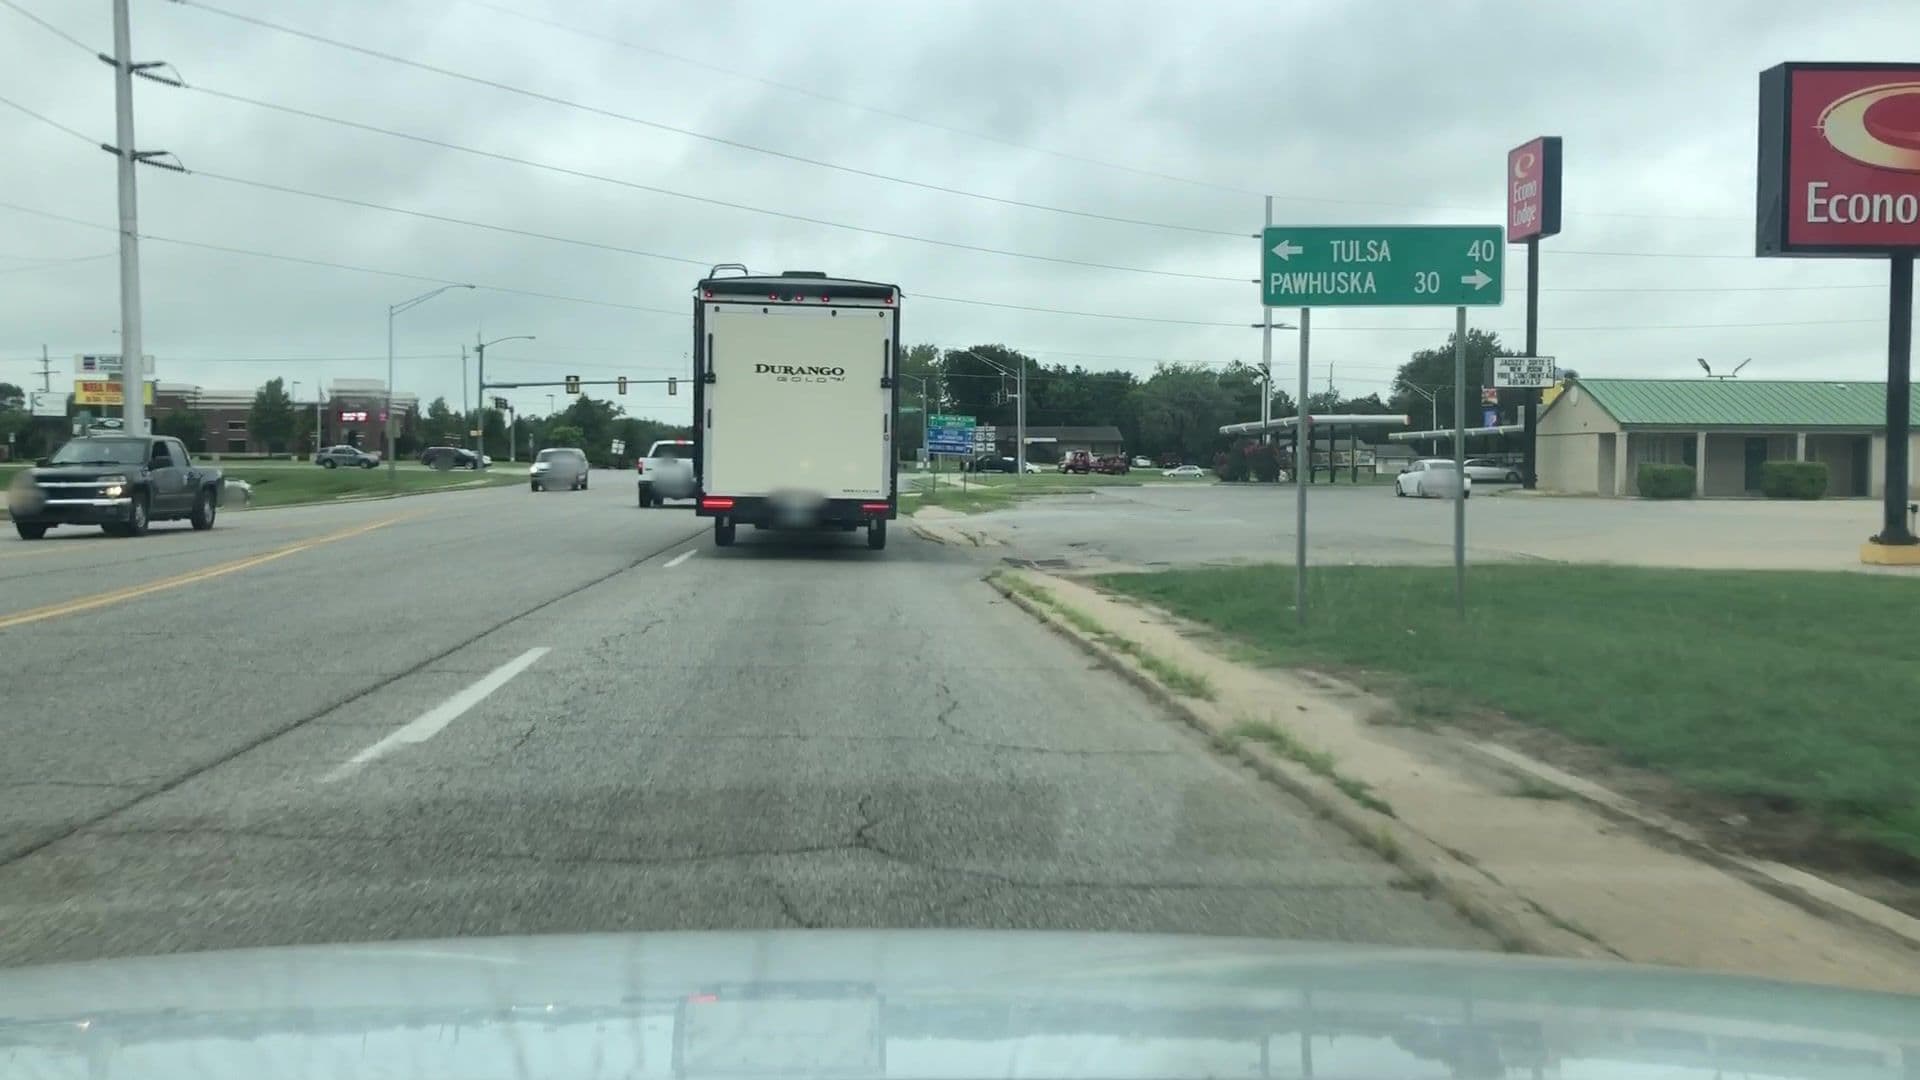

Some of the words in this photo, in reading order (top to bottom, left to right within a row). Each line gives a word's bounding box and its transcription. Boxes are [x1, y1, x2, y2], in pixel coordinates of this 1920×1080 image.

[1807, 181, 1918, 223] Econo
[1330, 239, 1391, 262] TULSA
[1466, 239, 1495, 262] 40
[1270, 271, 1377, 294] PAWHUSKA
[1413, 271, 1440, 294] 30
[755, 363, 845, 376] DURANGO
